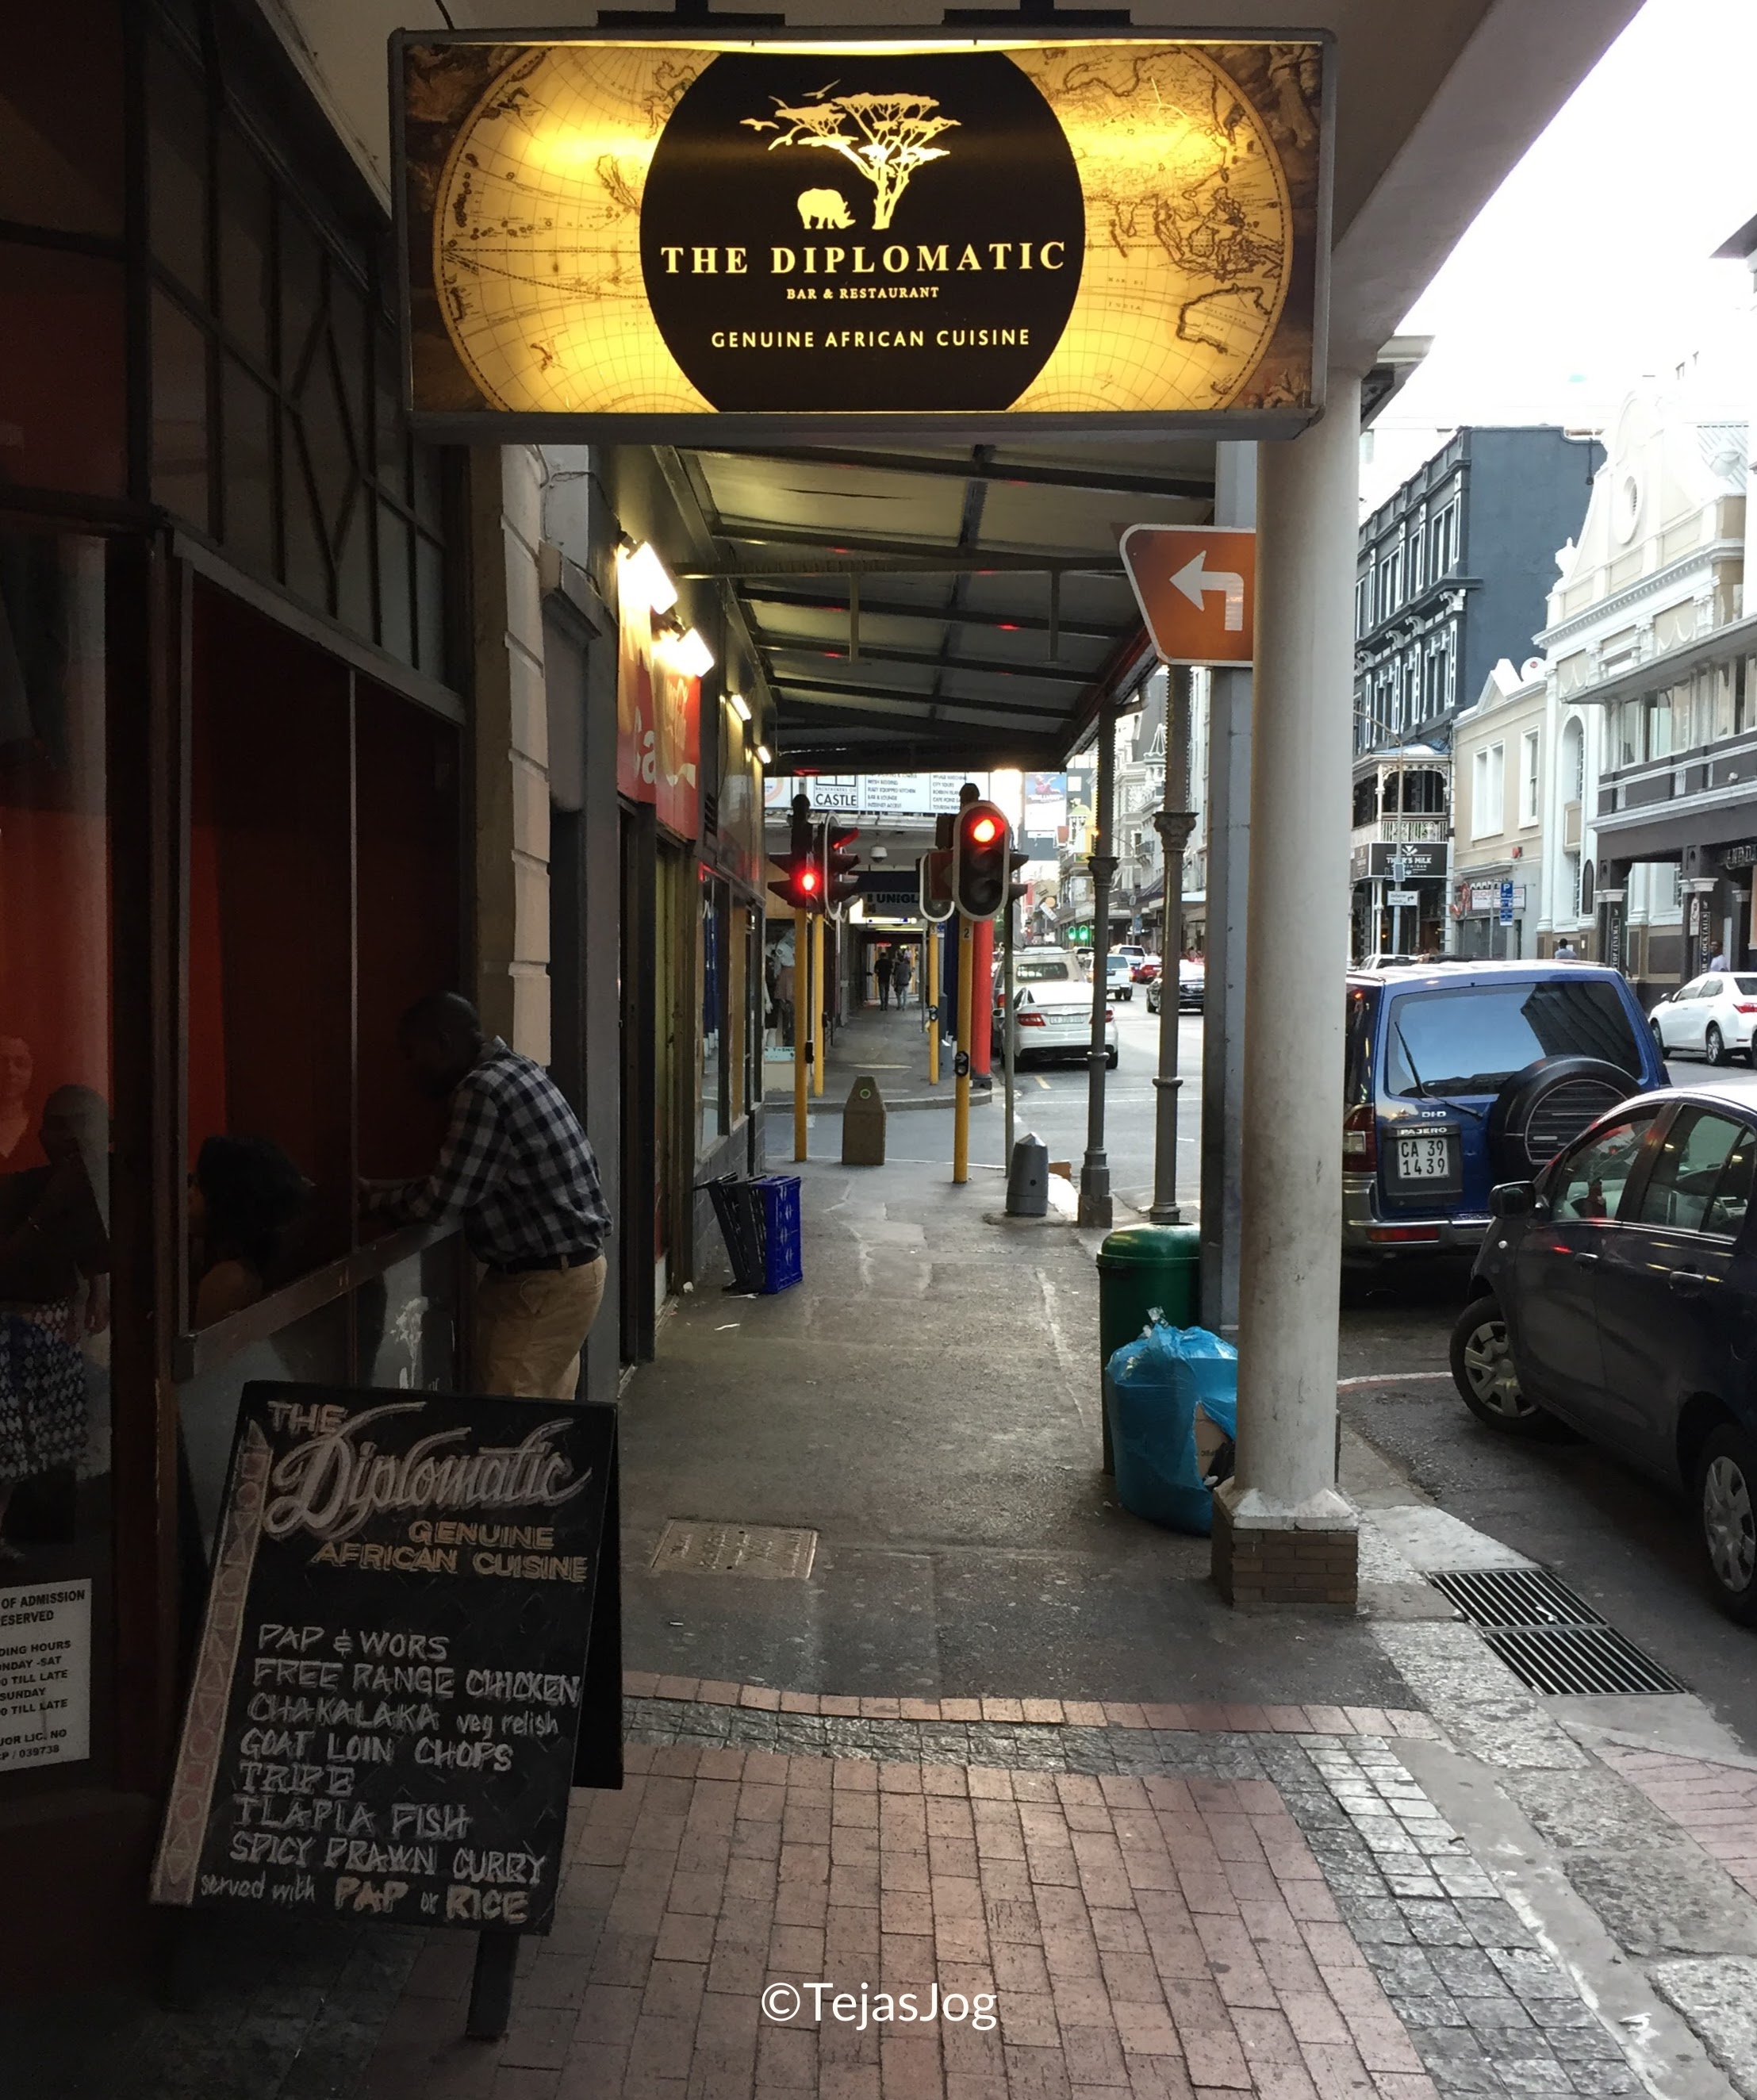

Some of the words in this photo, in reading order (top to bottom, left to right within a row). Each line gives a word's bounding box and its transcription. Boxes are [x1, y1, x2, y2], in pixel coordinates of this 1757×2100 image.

[661, 247, 748, 274] THE
[770, 241, 1066, 274] DIPLOMATIC
[787, 288, 817, 300] BAR
[823, 288, 833, 299] &
[840, 286, 939, 299] RESTAURANT
[712, 332, 815, 348] GENUINE
[825, 330, 924, 347] AFRICAN
[937, 329, 1030, 346] CUISINE
[815, 793, 857, 806] CASTLE
[964, 928, 969, 938] 2
[1401, 1142, 1418, 1157] CA
[1427, 1140, 1444, 1157] 39
[1403, 1158, 1444, 1176] 1439
[268, 1401, 347, 1436] THE
[264, 1401, 593, 1541] Diplomatic
[409, 1521, 554, 1550] GENUINE
[309, 1541, 458, 1574] AFRICAN
[473, 1553, 587, 1583] CUISINE
[2, 1597, 17, 1609] OF
[21, 1590, 85, 1607] ADMISSION
[31, 1641, 71, 1652] HOURS
[258, 1624, 324, 1651] PAP
[360, 1630, 449, 1662] WORS
[36, 1656, 62, 1666] -SAT
[11, 1674, 36, 1684] TILL
[40, 1669, 68, 1681] LATE
[254, 1657, 343, 1687] FREE
[353, 1663, 455, 1698] RANGE
[466, 1669, 580, 1706] CHICKEN
[0, 1687, 46, 1701] SUNDAY
[11, 1704, 36, 1714] TILL
[40, 1699, 68, 1710] LATE
[247, 1691, 439, 1730] CHAKALAKA
[456, 1714, 493, 1739] veg
[501, 1710, 558, 1735] relish
[51, 1729, 67, 1739] NO
[19, 1745, 59, 1758] 039738
[240, 1728, 316, 1759] GOAT
[327, 1732, 394, 1764] LOIN
[415, 1736, 513, 1771] CHOPS
[238, 1760, 354, 1792] TRIPE
[391, 1803, 473, 1841] FISH
[229, 1830, 316, 1868] SPICY
[323, 1837, 435, 1875] PRAWN
[452, 1847, 546, 1883] CURRY
[200, 1872, 265, 1900] served
[273, 1874, 315, 1902] with
[335, 1877, 409, 1914] PAP
[446, 1885, 528, 1923] RICE
